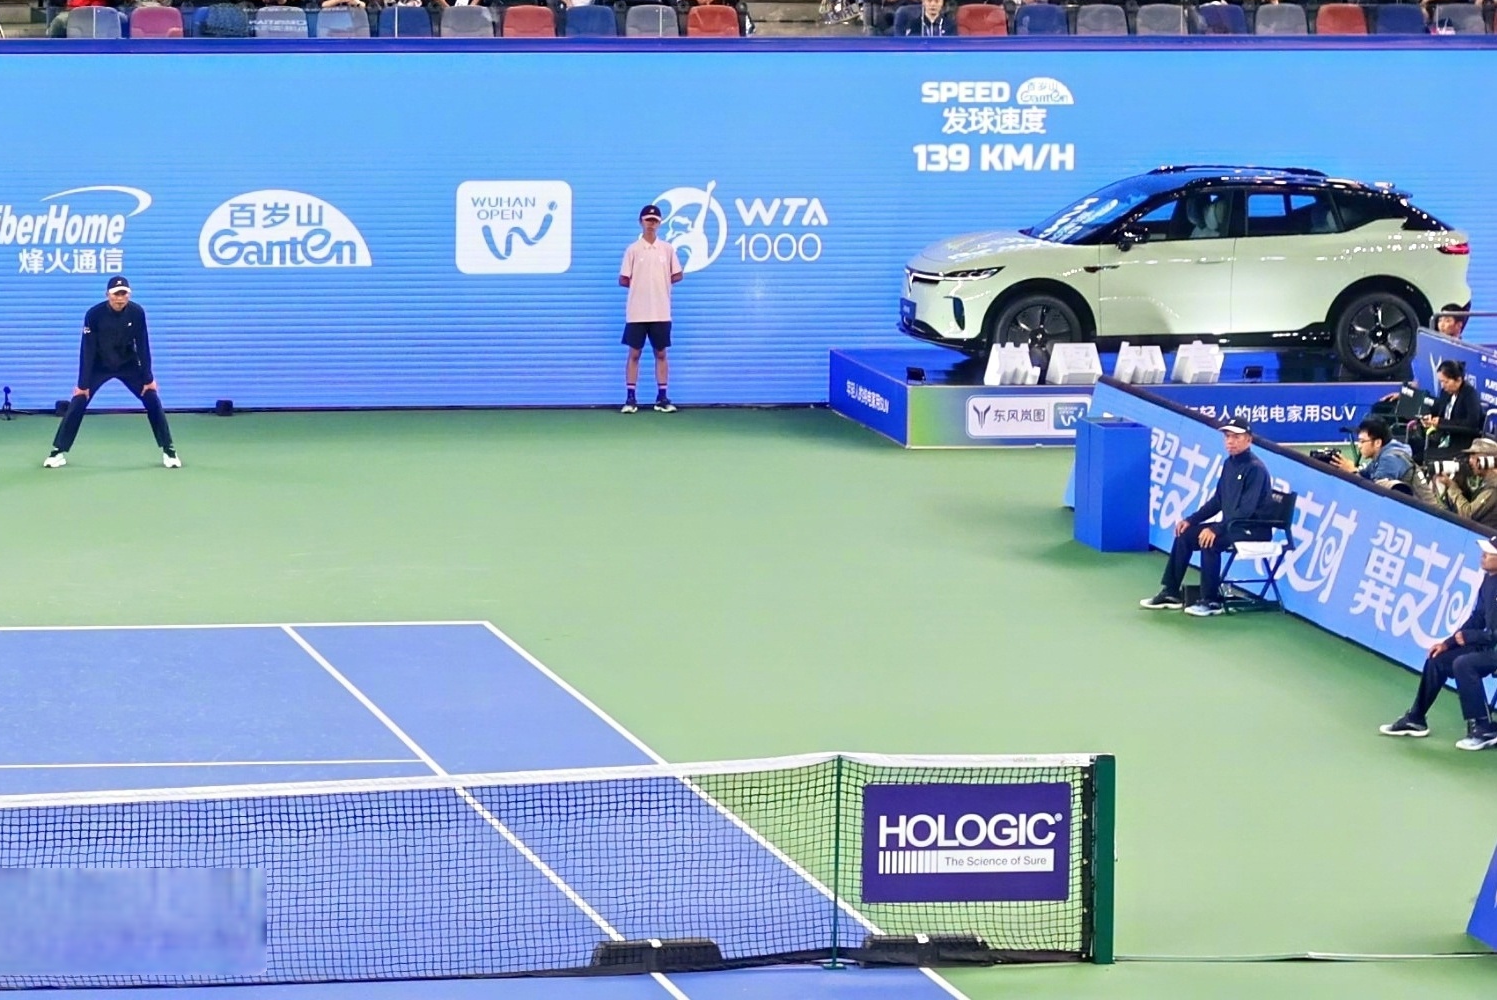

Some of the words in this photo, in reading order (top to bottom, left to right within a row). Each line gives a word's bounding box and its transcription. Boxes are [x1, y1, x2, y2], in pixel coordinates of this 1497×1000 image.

[921, 81, 1011, 104] SPEED
[941, 105, 1047, 135] 发球速度
[912, 143, 971, 172] 139
[980, 143, 1075, 171] KM/H
[229, 202, 324, 229] 百岁山
[471, 196, 536, 208] WUHAN
[476, 208, 523, 221] OPEN
[735, 197, 829, 226] WTA
[734, 232, 822, 262] 1000
[18, 247, 124, 275] 烽火通信
[994, 408, 1046, 423] 东风岚图
[1185, 404, 1357, 424] 轻人的纯电家用SUV
[878, 812, 1057, 849] HOLOGIC
[944, 856, 964, 867] The
[966, 855, 1009, 867] Science
[1010, 855, 1022, 866] of
[1023, 855, 1048, 866] Sure
